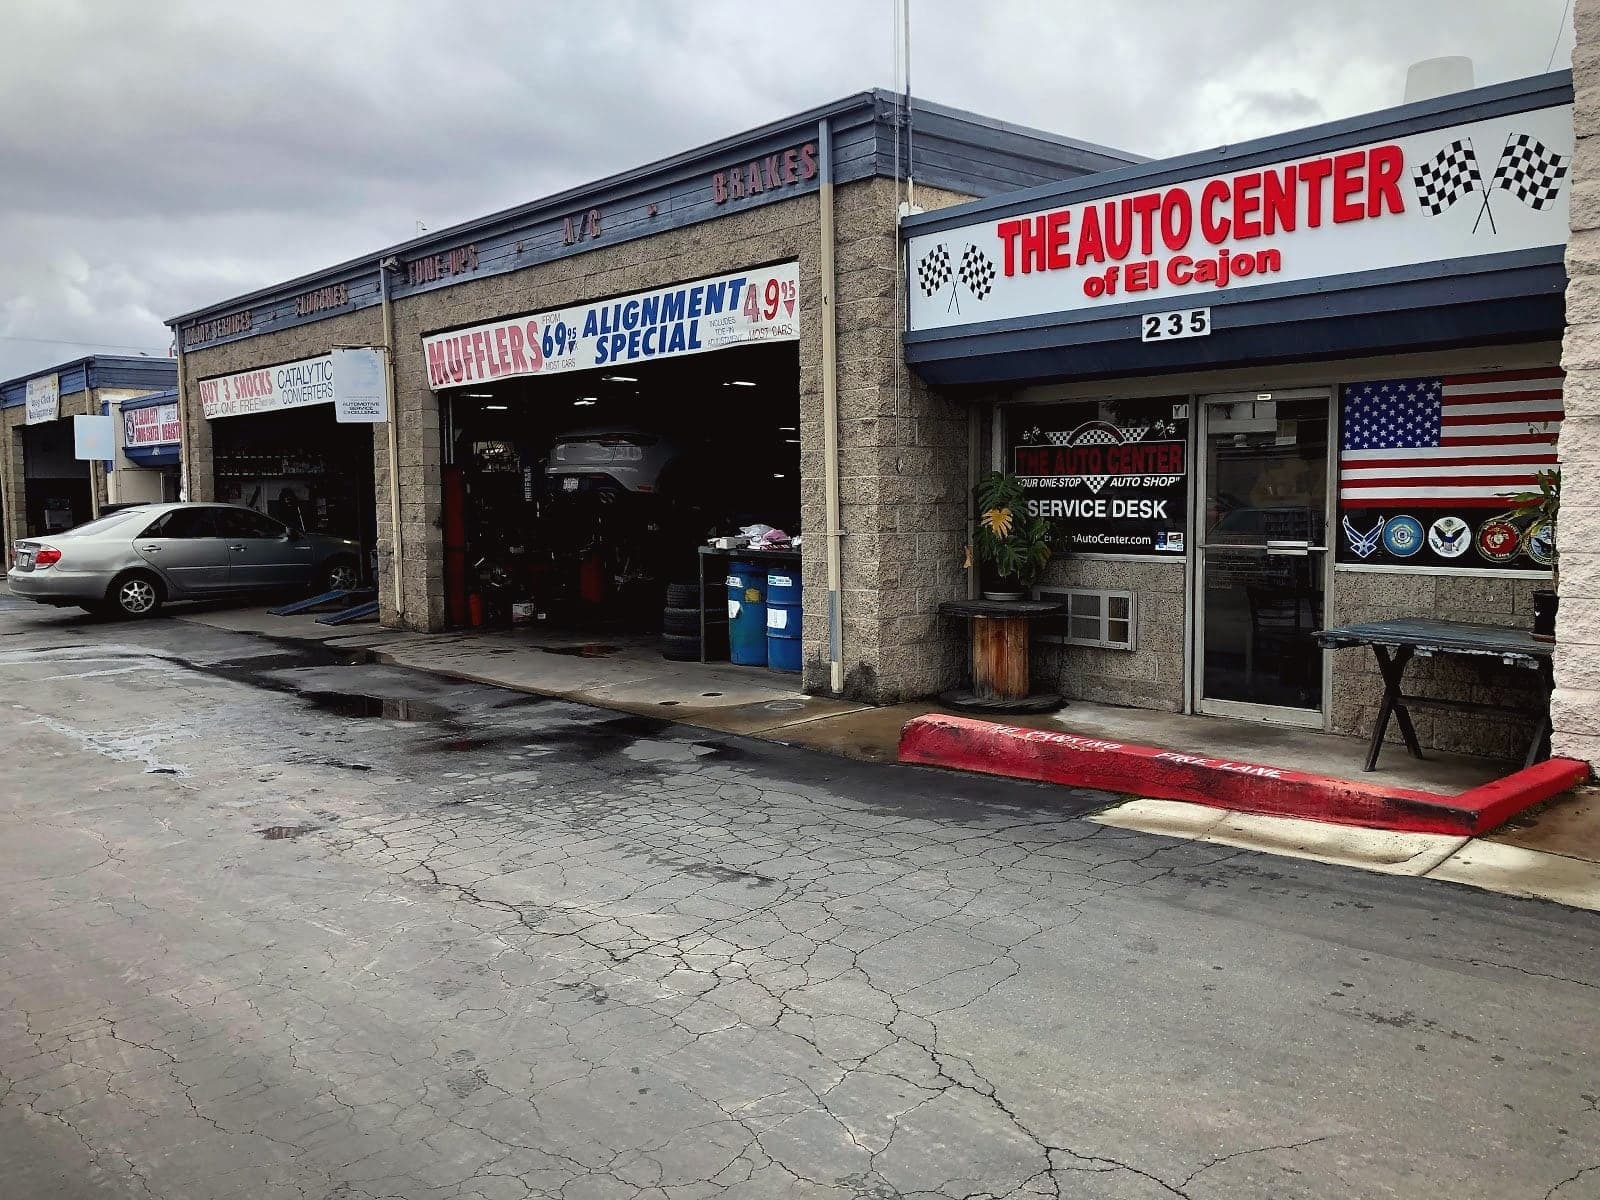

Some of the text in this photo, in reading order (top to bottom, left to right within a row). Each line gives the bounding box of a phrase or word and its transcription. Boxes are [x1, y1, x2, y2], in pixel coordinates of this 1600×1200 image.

[713, 143, 818, 204] BRAKES
[998, 144, 1406, 278] THE AUTO CENTER
[562, 209, 602, 246] A/C
[1083, 248, 1282, 298] of El Cajon
[542, 312, 561, 325] FROM
[582, 277, 747, 338] ALIGNMENT
[211, 310, 252, 340] SERVICES
[748, 324, 793, 341] MOST CARS
[1145, 310, 1207, 338] 235
[427, 321, 544, 386] MUFFLERS
[595, 319, 702, 365] SPECIAL
[201, 370, 274, 404] BUY 3 SHOCKS
[277, 360, 333, 389] CATALYTIC
[204, 403, 219, 417] GET
[220, 401, 237, 415] ONE
[240, 398, 260, 412] FREE
[281, 382, 334, 405] CONVERTERS
[1016, 444, 1183, 475] THE AUTO CENTER
[1017, 478, 1082, 489] OUR ONE-STOP
[1110, 476, 1140, 488] AUTO
[1027, 499, 1168, 519] SERVICE DESK
[1024, 730, 1122, 751] PARKING
[1153, 752, 1292, 780] FIRE LANE
